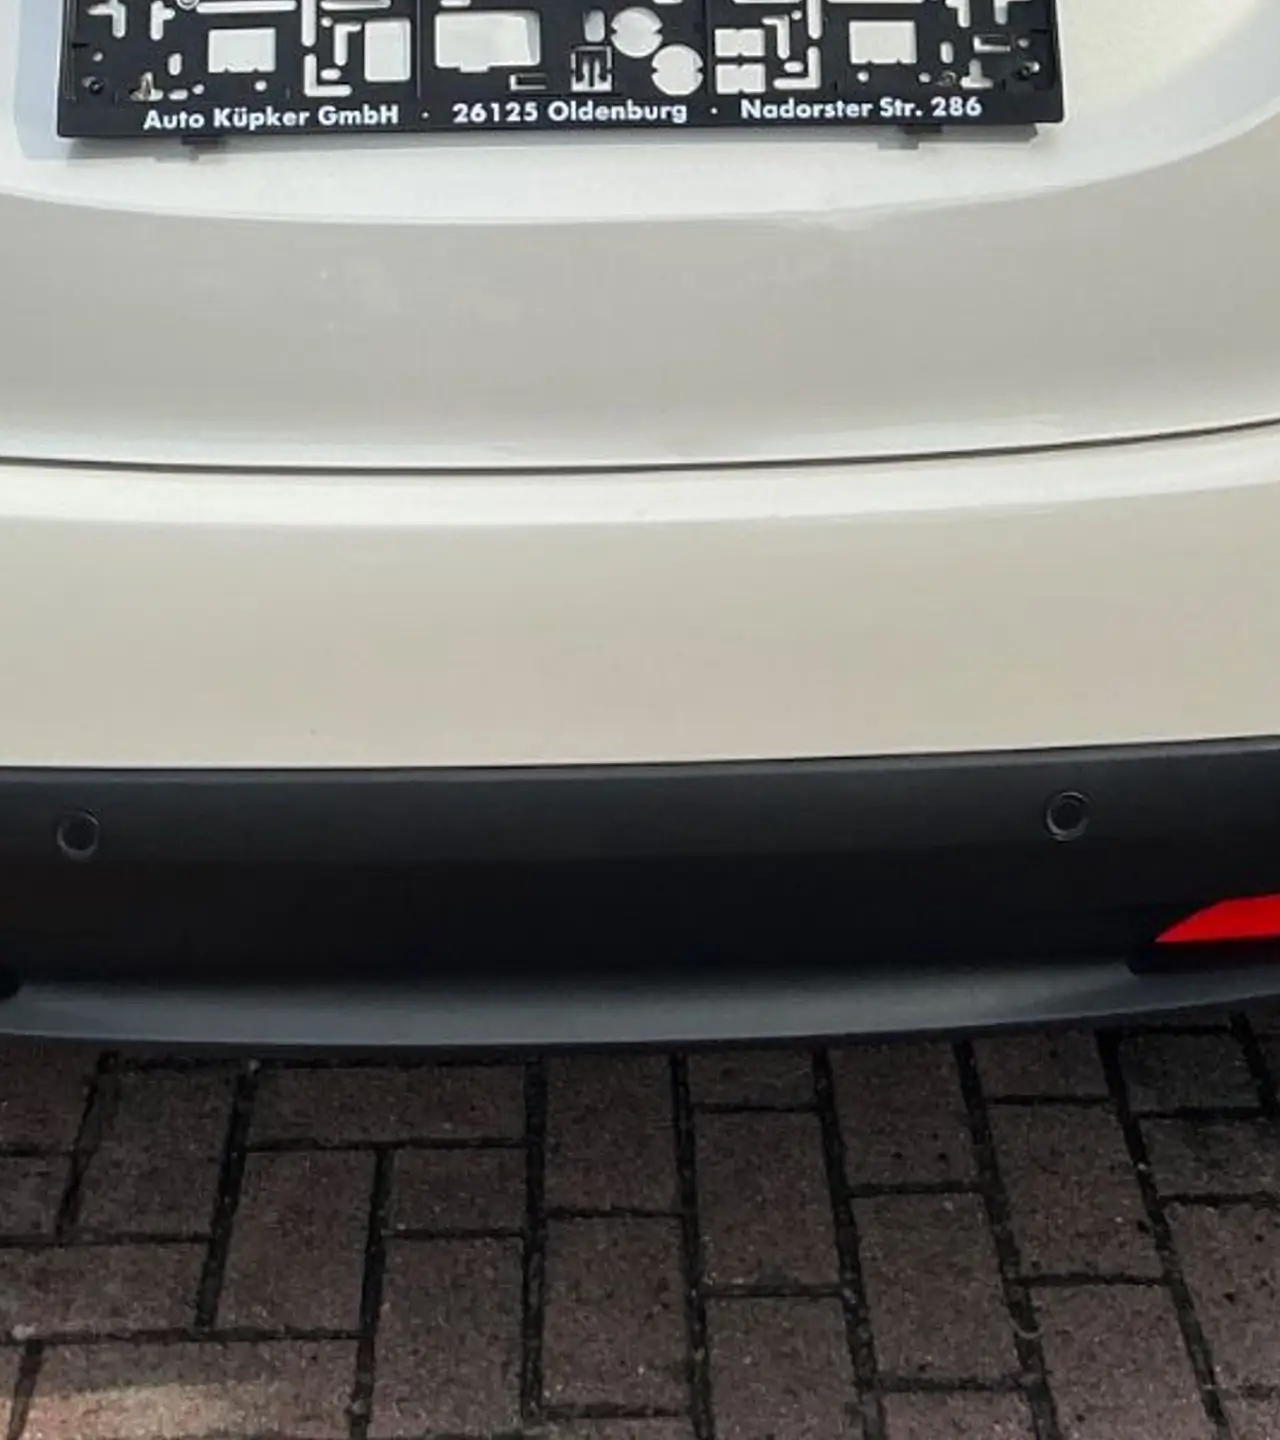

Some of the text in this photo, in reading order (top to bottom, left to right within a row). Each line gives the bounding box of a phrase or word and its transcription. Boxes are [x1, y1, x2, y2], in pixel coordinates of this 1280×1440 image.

[142, 95, 983, 131] Auto Küpker GmbH 26125 Oldenburg Nadorster Str. 286
